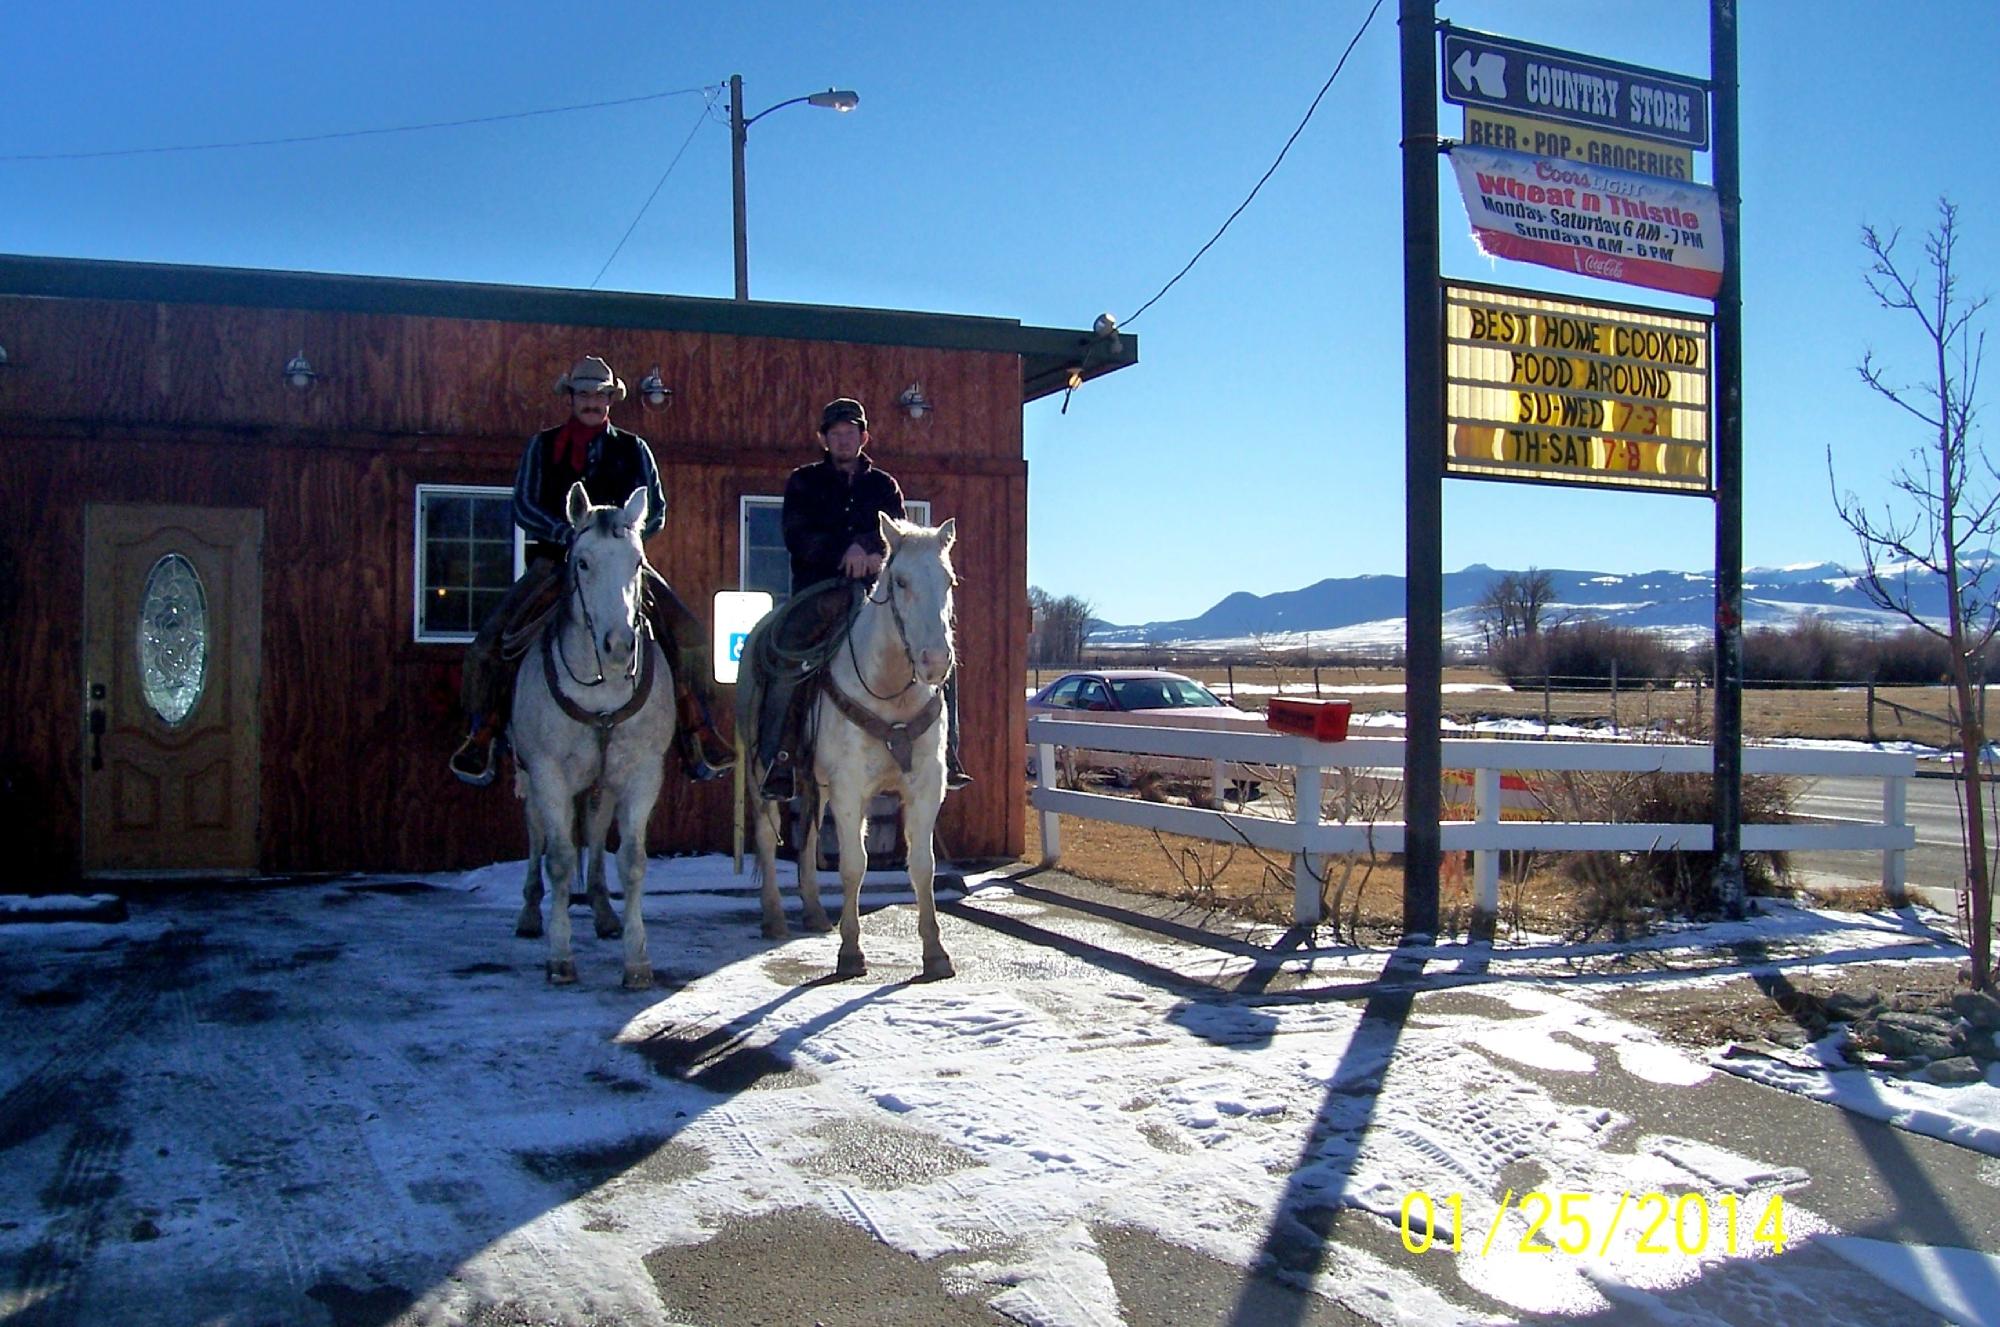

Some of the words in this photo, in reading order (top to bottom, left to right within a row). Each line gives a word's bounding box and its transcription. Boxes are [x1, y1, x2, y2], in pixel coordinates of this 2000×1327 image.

[1526, 63, 1619, 118] COUNTRY
[1630, 85, 1690, 133] STORE
[1470, 119, 1517, 149] BEER
[1535, 131, 1571, 159] POP
[1588, 140, 1686, 180] GROCERIES
[1476, 172, 1576, 208] Wheat
[1582, 191, 1600, 213] n
[1606, 194, 1699, 230] Thistle
[1533, 160, 1591, 188] Coors
[1591, 176, 1646, 197] LIGHT
[1515, 222, 1580, 246] Sunday
[1597, 238, 1623, 254] AM
[1649, 246, 1674, 262] PM
[1550, 208, 1621, 236] Saturday
[1623, 220, 1635, 237] 6
[1636, 222, 1661, 241] AM
[1671, 228, 1679, 245] 7
[1681, 230, 1704, 249] PM
[1470, 308, 1531, 343] BEST
[1543, 316, 1601, 353] HOME
[1614, 329, 1698, 365] COOKED
[1510, 352, 1573, 388] FOOD
[1585, 362, 1671, 399] AROUND
[1519, 392, 1604, 429] SU-WED
[1620, 402, 1658, 435] 7-3
[1510, 430, 1592, 467] TH-SAT
